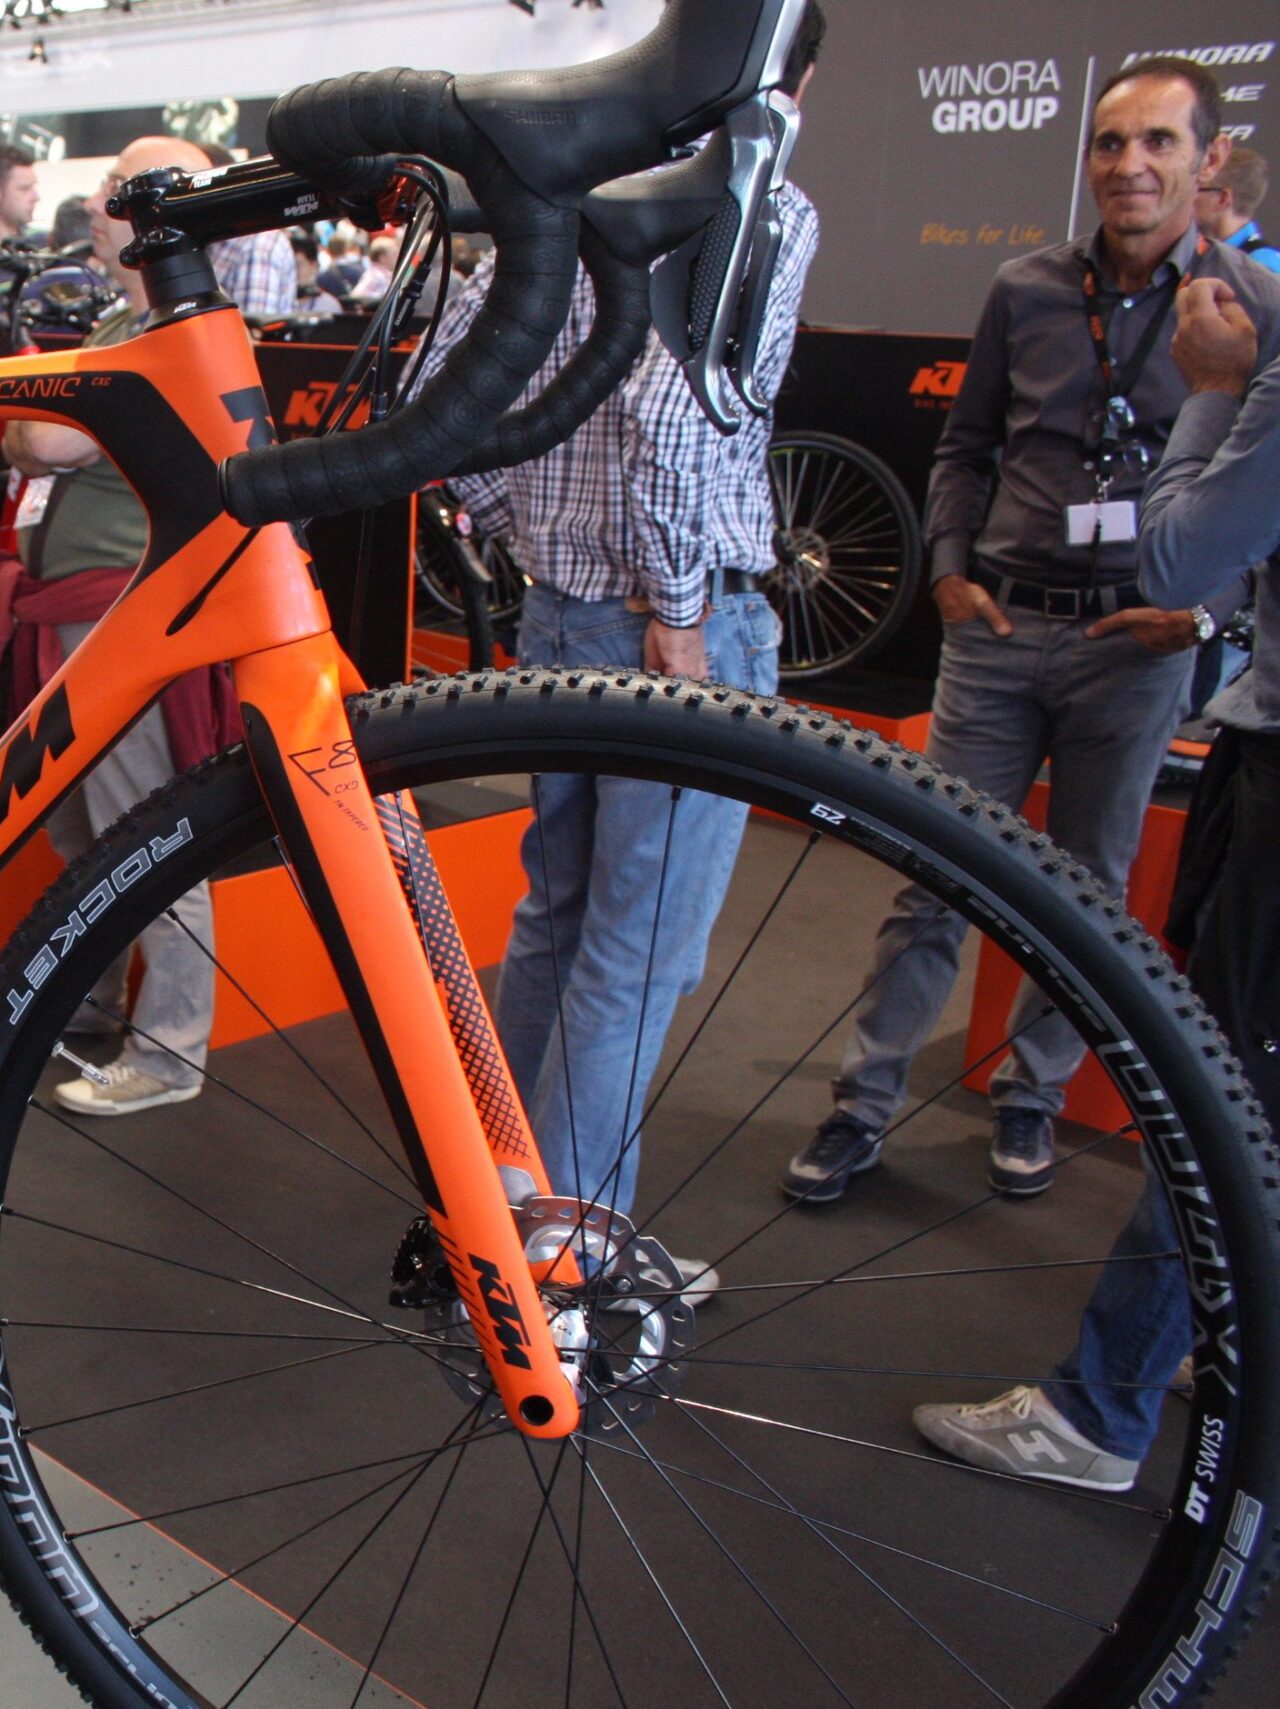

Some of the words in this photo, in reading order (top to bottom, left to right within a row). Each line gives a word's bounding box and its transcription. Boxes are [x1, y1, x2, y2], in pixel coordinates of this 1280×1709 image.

[917, 58, 1061, 98] WINORA
[932, 96, 1059, 133] GROUP
[909, 361, 968, 397] KT
[6, 816, 194, 1025] ROCKET
[467, 1252, 532, 1371] KTM
[1195, 1413, 1225, 1483] SWISS
[1183, 1480, 1211, 1524] DT
[1127, 1488, 1264, 1709] SCHW
